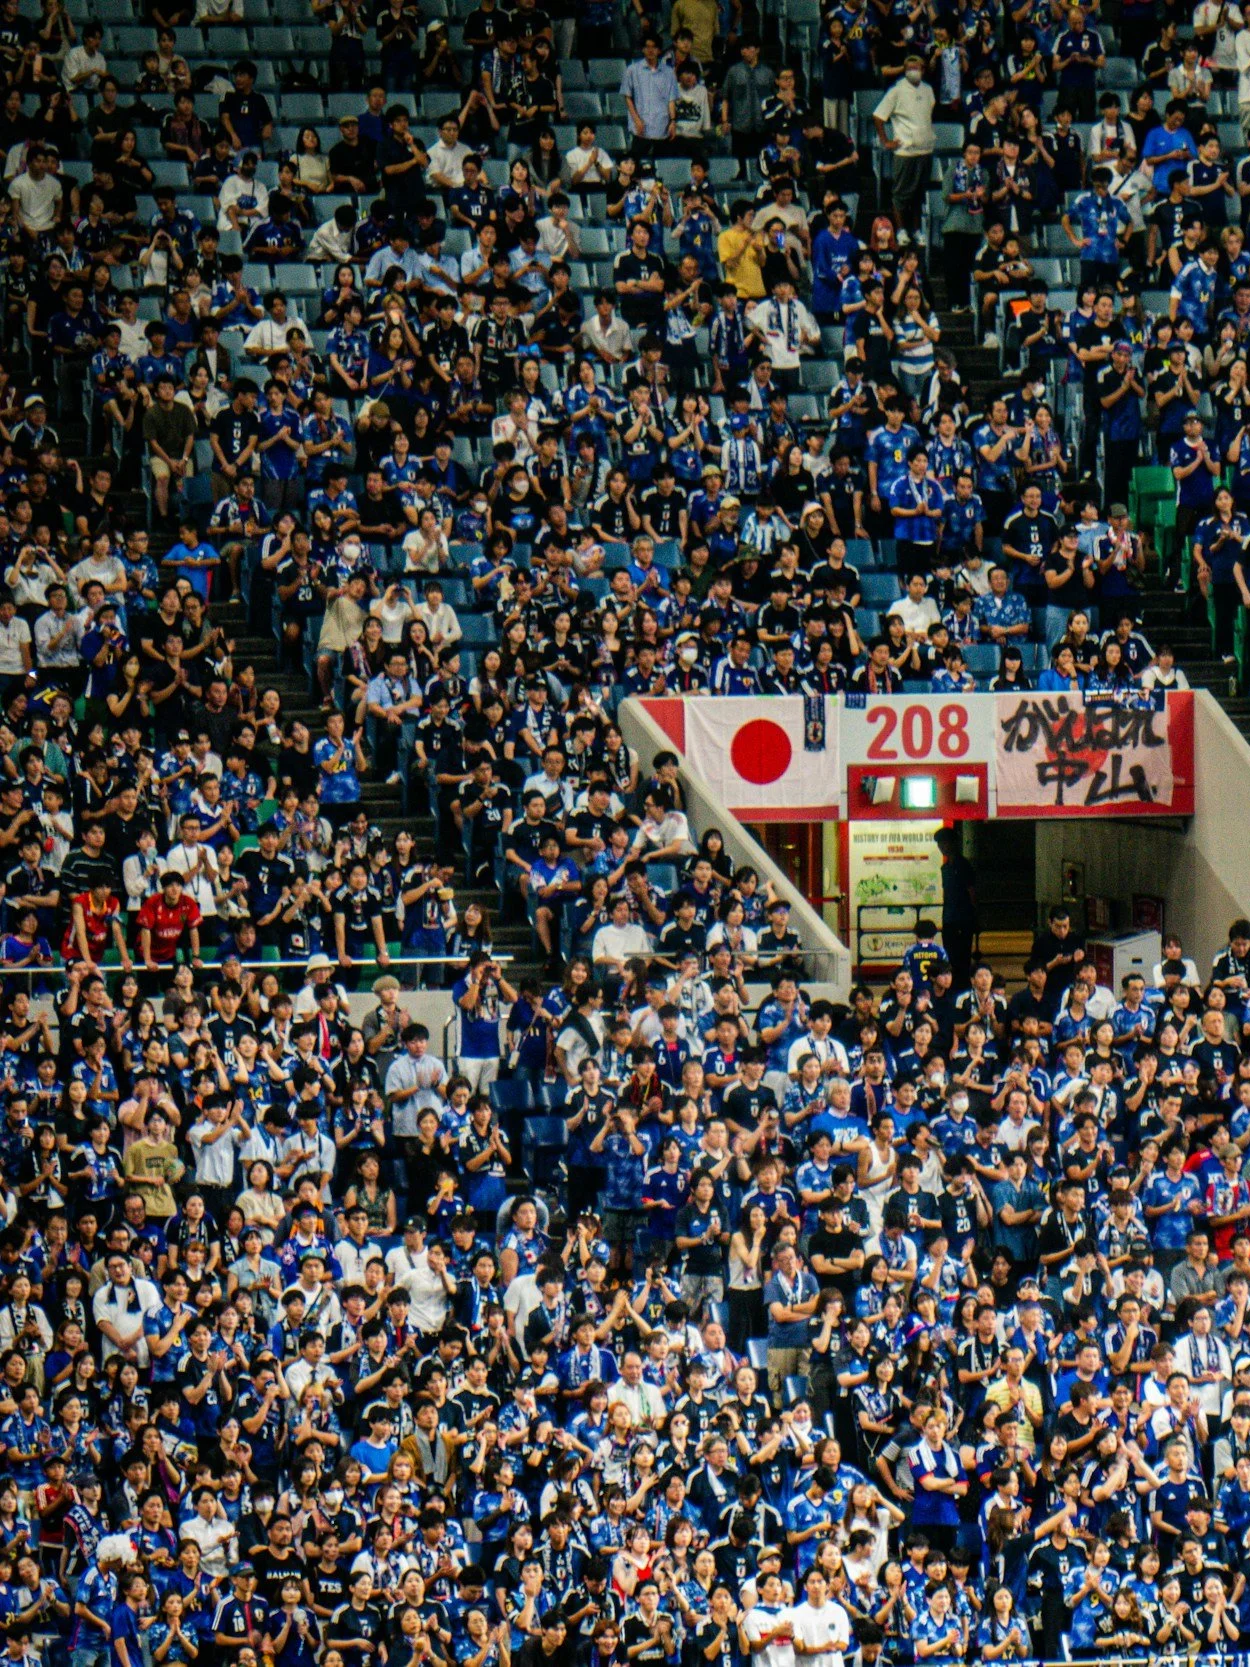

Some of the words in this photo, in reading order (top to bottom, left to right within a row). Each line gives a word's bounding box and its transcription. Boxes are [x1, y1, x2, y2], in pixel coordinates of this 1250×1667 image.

[866, 704, 970, 760] 208
[1036, 750, 1156, 806] 中山
[853, 833, 879, 843] HISTORY
[880, 833, 887, 842] OF
[888, 833, 900, 842] FIFA
[902, 832, 923, 842] WORLD
[956, 1218, 970, 1233] 20
[319, 1580, 342, 1593] YES
